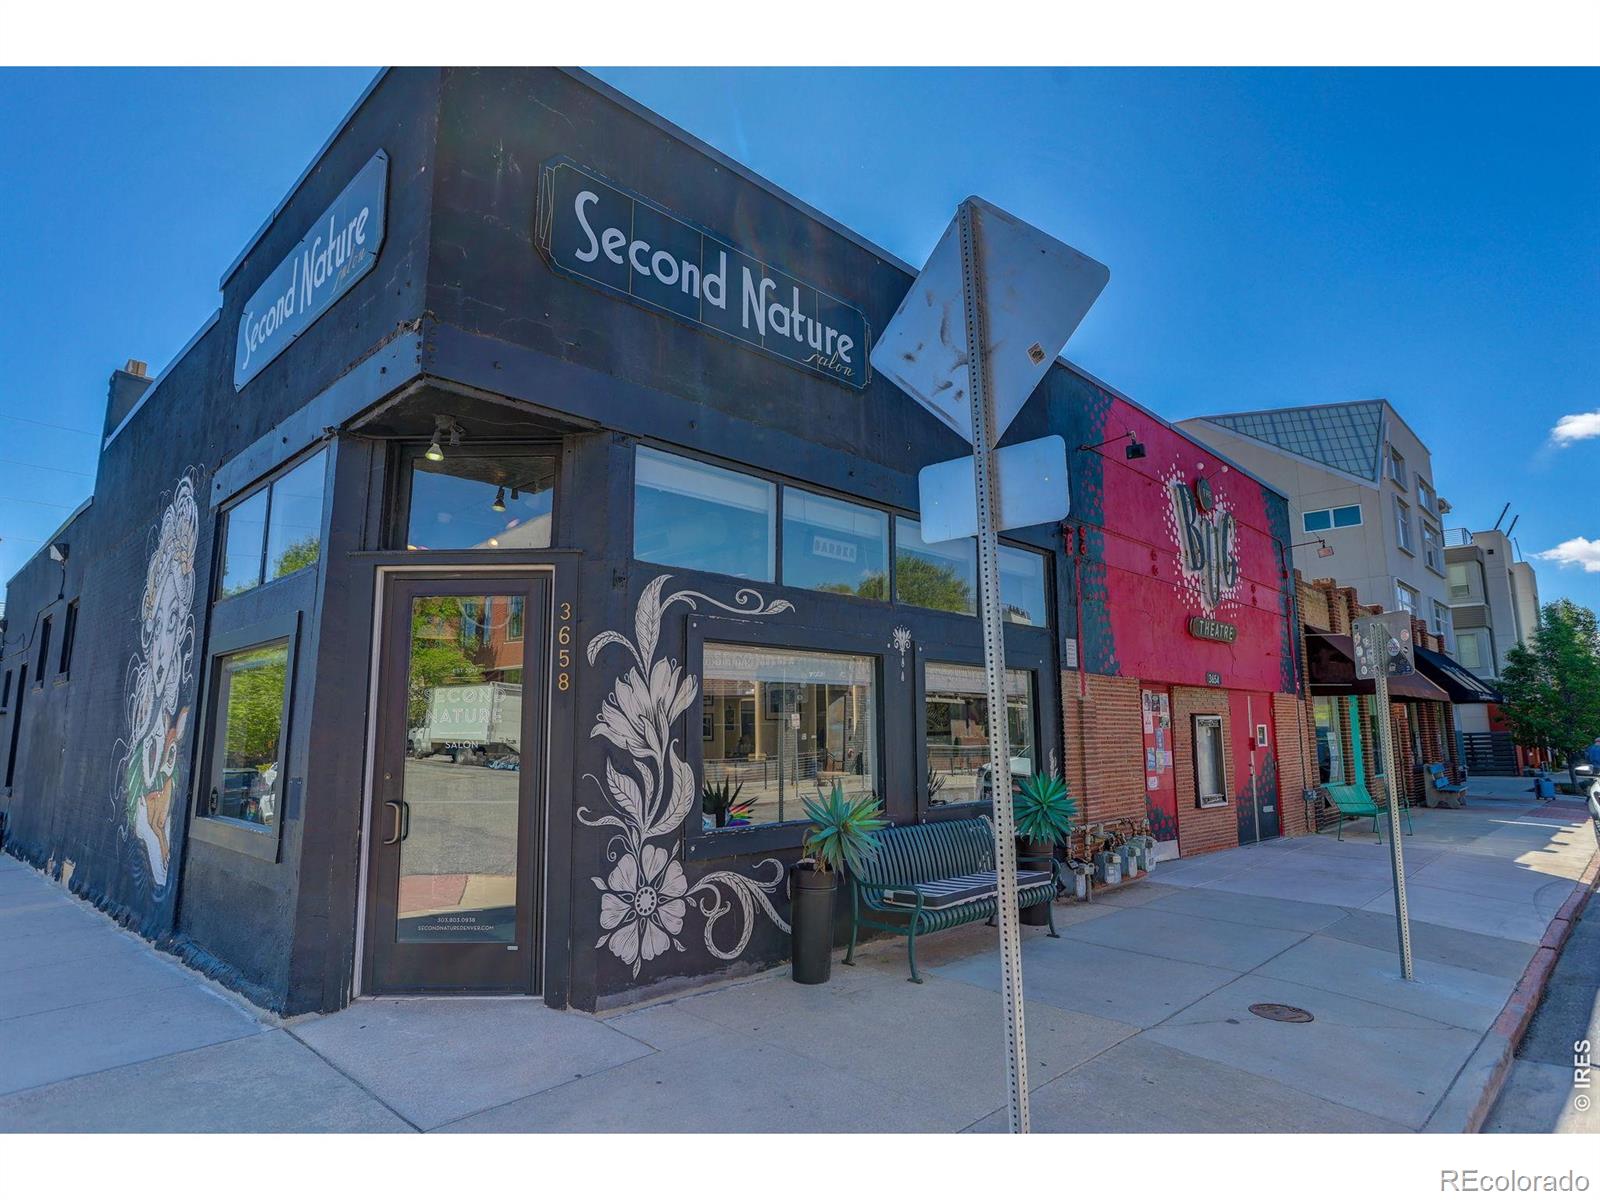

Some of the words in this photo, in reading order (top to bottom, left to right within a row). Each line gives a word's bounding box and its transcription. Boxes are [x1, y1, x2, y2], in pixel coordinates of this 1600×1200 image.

[574, 190, 727, 310] Second
[742, 266, 854, 363] Nature
[241, 257, 298, 370] Second
[300, 207, 370, 314] Nature
[801, 352, 856, 377] salon
[1199, 620, 1233, 641] THEATRE
[558, 602, 571, 691] 3658
[423, 688, 507, 703] SECOND
[426, 708, 502, 724] NATURE
[445, 740, 479, 749] SALON
